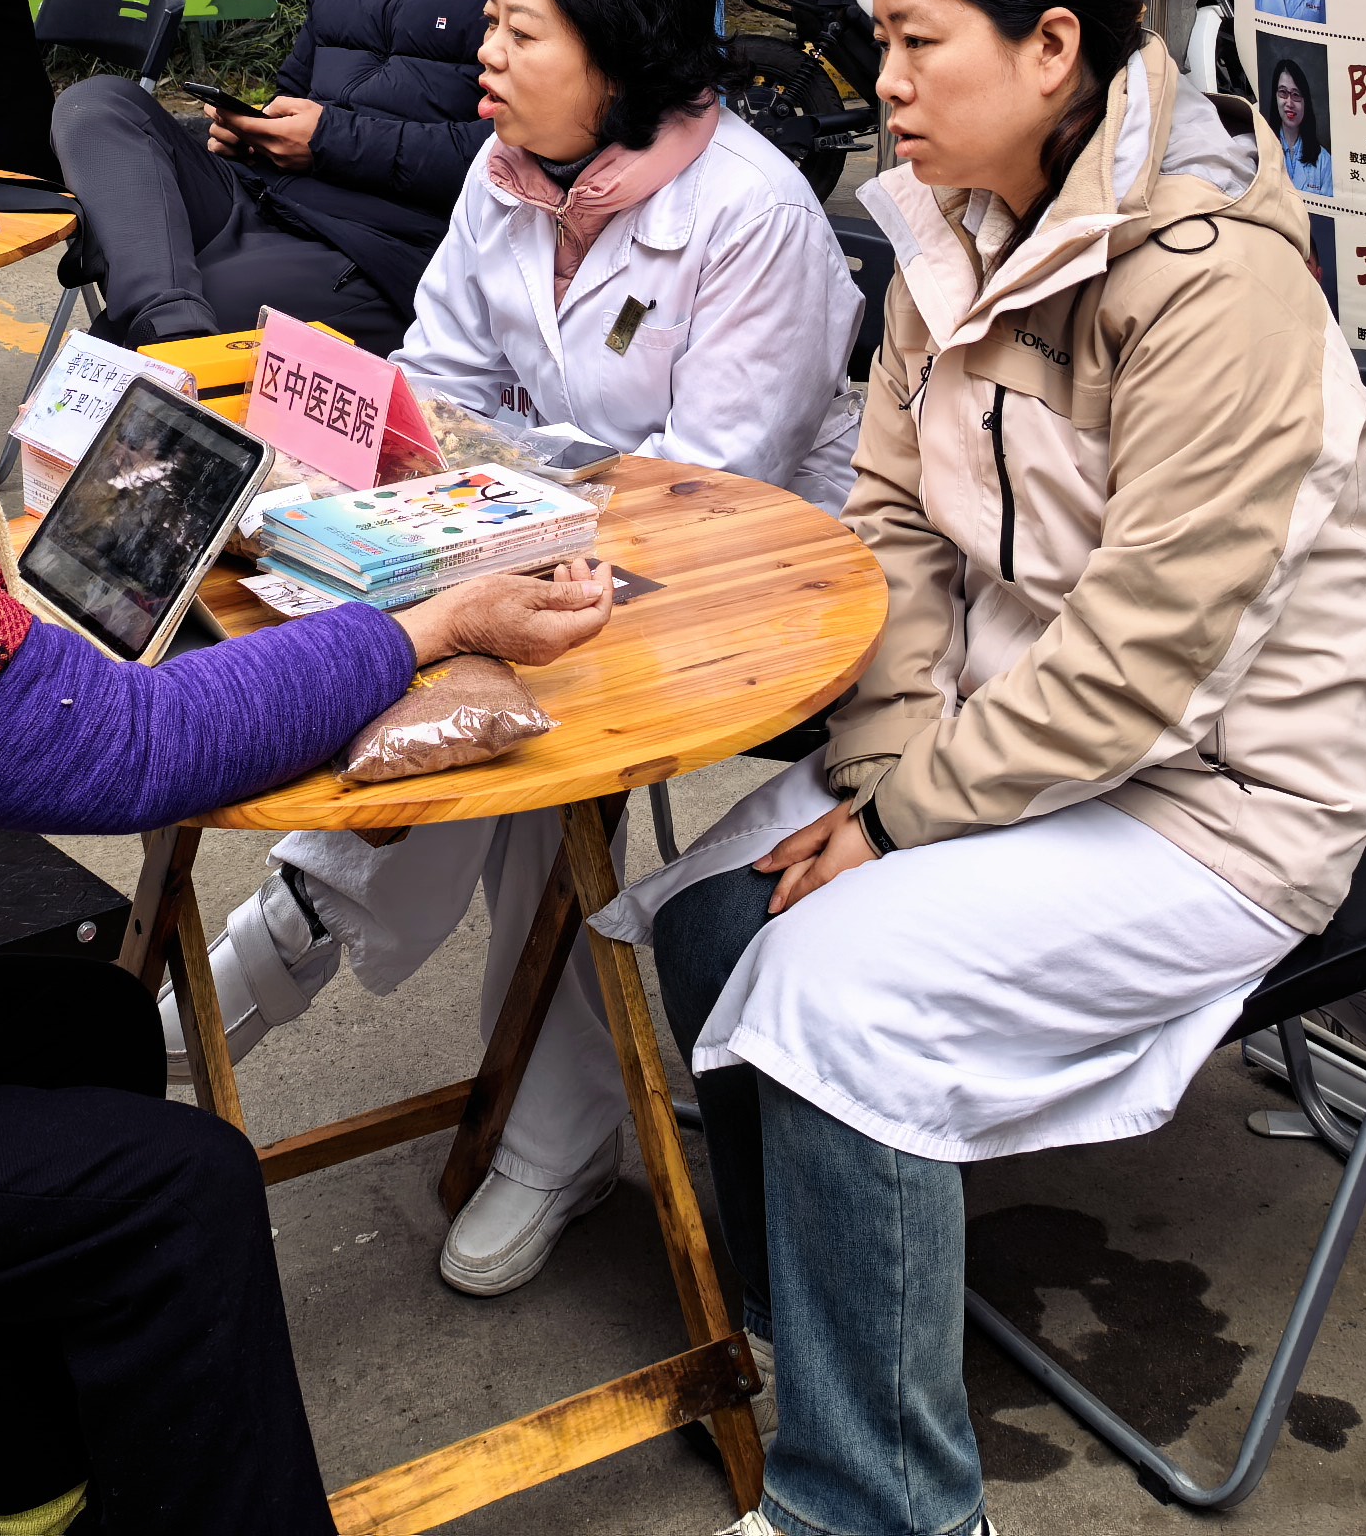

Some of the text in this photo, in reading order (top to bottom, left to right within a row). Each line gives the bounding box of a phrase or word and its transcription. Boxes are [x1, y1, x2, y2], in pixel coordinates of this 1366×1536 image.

[65, 353, 133, 393] 普陀区中医
[259, 351, 379, 449] 区中医医院
